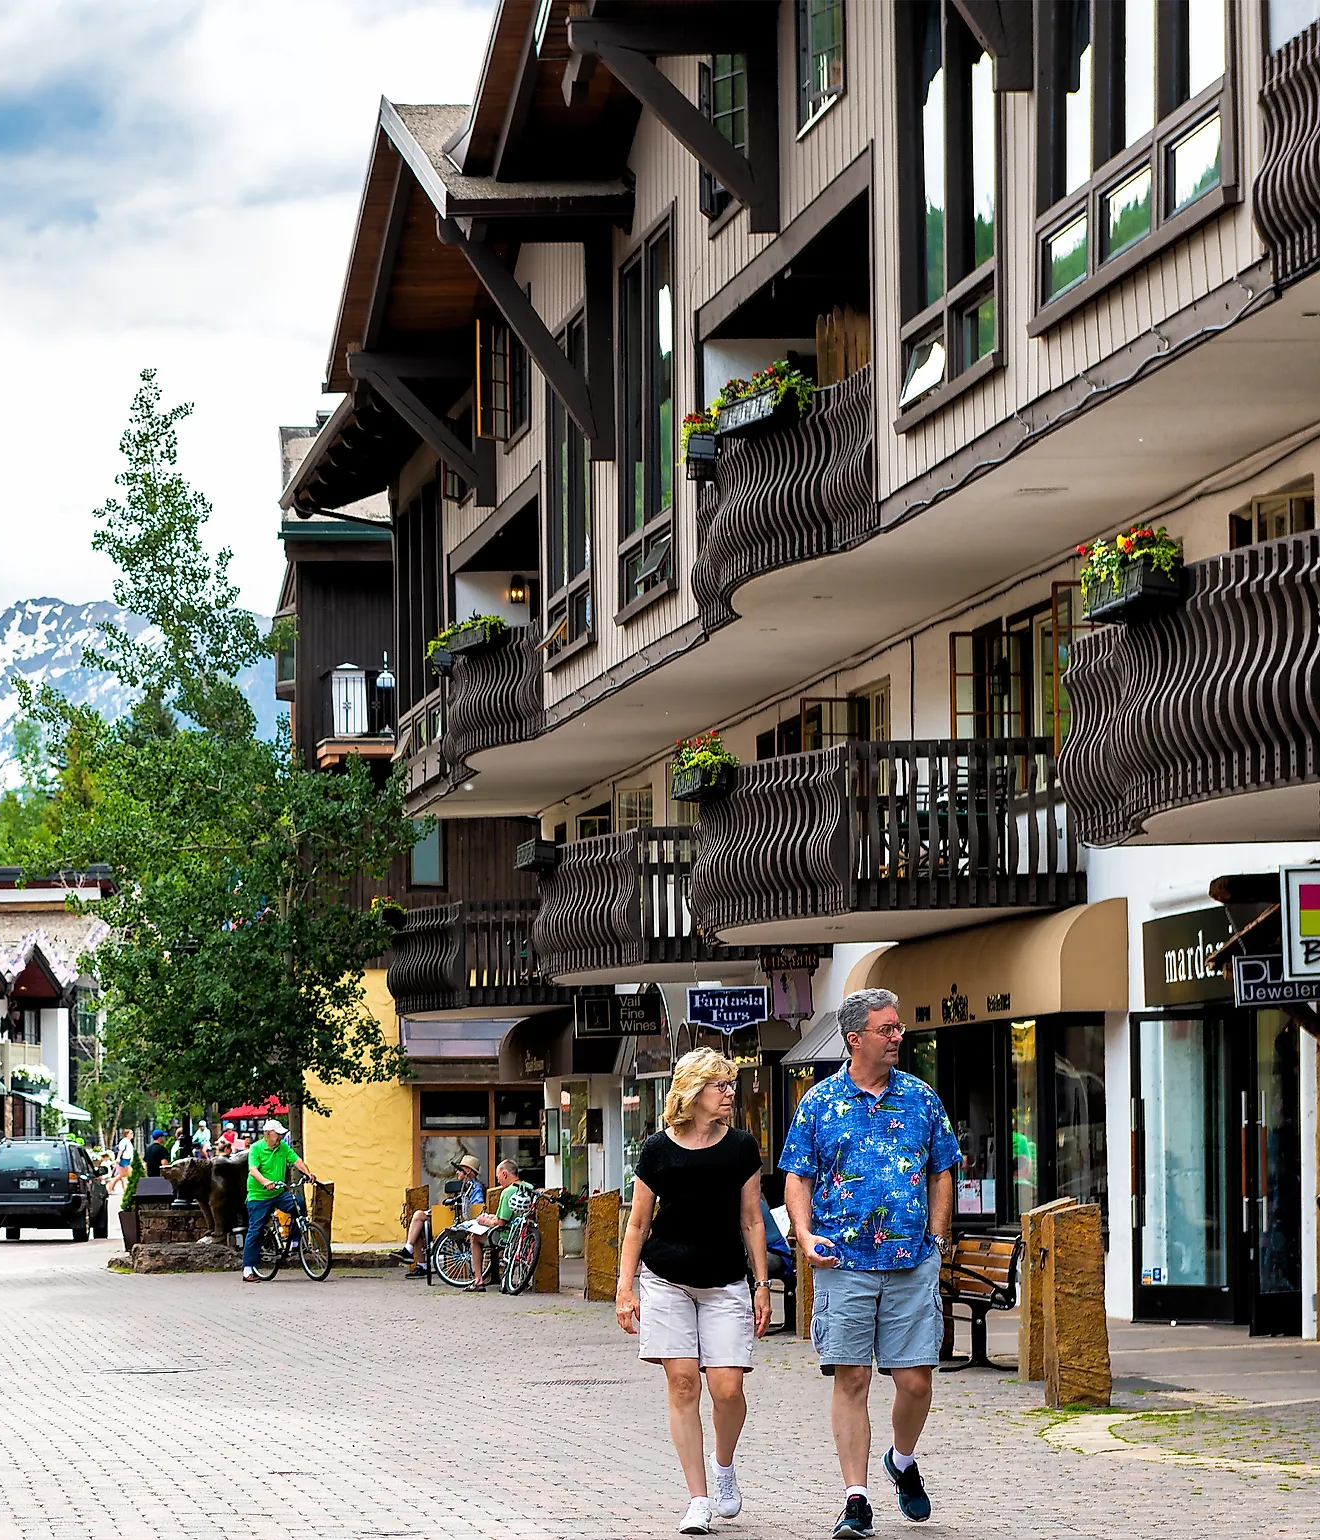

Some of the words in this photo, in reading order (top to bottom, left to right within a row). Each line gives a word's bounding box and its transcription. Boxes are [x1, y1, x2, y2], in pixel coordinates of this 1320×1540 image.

[619, 995, 641, 1007] Vail
[692, 994, 763, 1008] Fantasia
[620, 1007, 645, 1020] Fine
[710, 1008, 750, 1022] Furs
[620, 1020, 657, 1032] Wines
